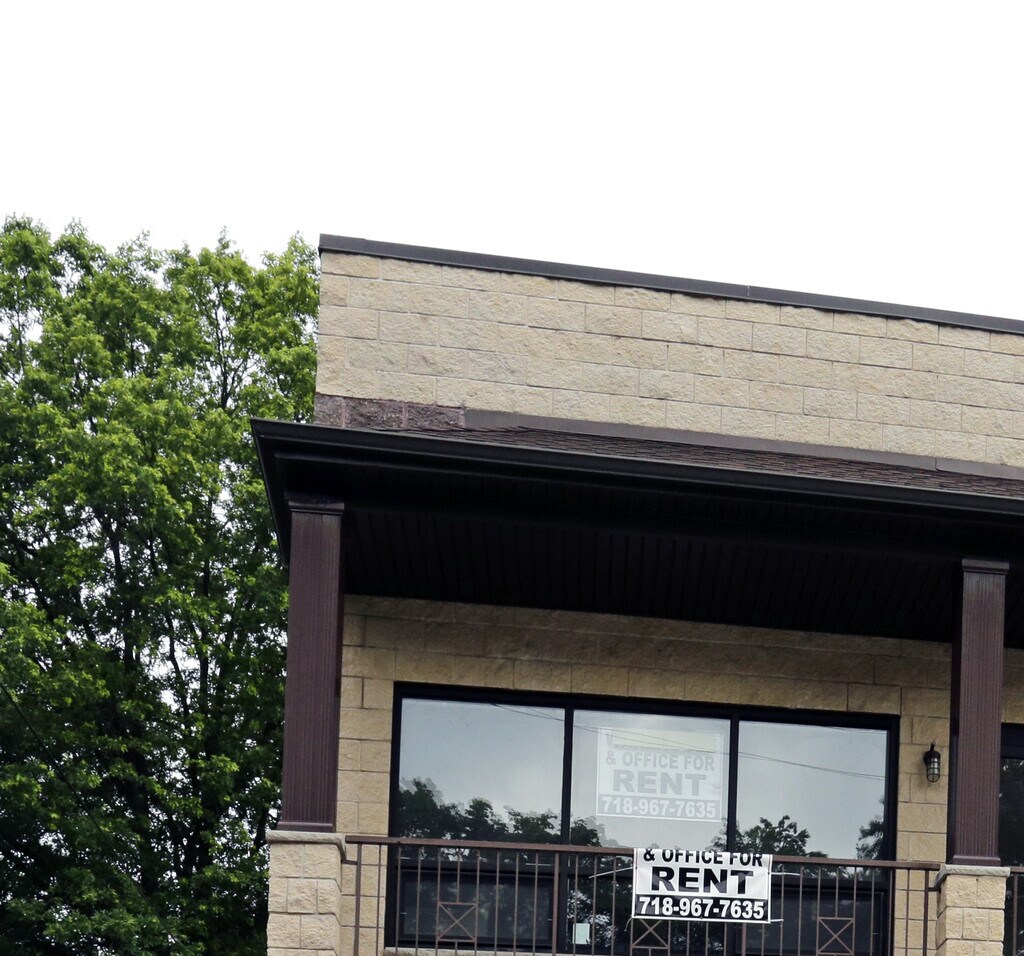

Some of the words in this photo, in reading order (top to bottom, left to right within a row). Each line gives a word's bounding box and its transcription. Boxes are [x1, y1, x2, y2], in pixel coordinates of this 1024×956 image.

[605, 750, 616, 766] &
[622, 751, 679, 770] OFFICE
[683, 754, 715, 772] FOR
[612, 768, 707, 797] RENT
[602, 796, 716, 818] 718-967-7635
[643, 848, 656, 862] &
[661, 848, 723, 865] OFFICE
[729, 851, 763, 867] FOR
[650, 866, 754, 895] RENT
[639, 896, 765, 919] 718-967-7635
